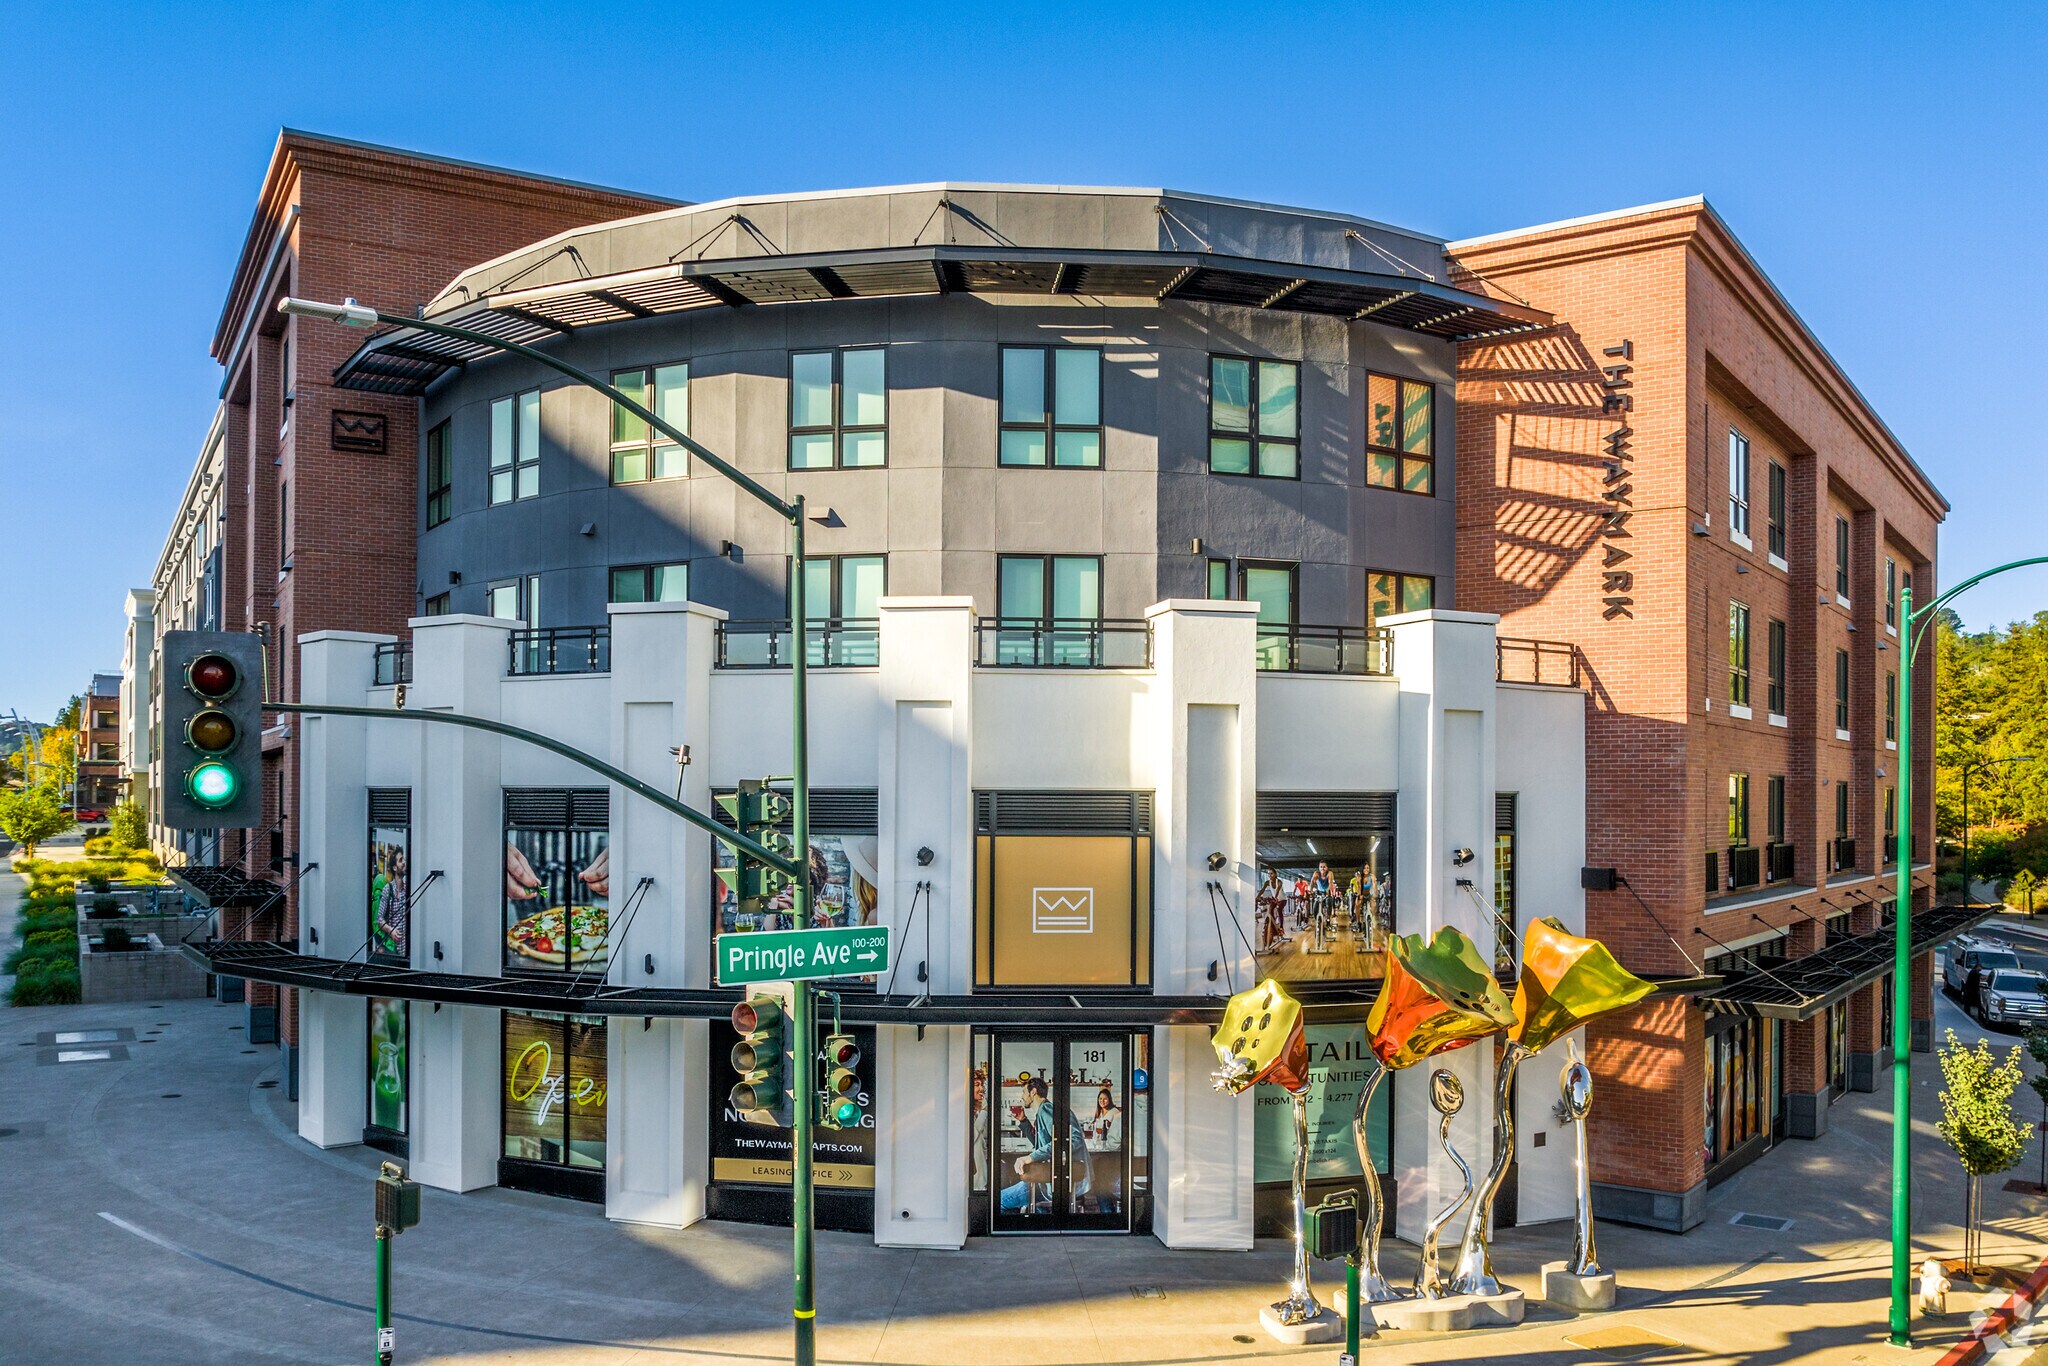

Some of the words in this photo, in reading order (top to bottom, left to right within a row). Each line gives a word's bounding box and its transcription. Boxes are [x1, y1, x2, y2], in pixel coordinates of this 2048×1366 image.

[1602, 339, 1633, 413] THE
[1602, 427, 1633, 621] WAYMARK
[729, 944, 805, 976] Pringle
[811, 942, 851, 966] Ave
[852, 937, 885, 948] 100-200
[1083, 1050, 1106, 1062] 181
[1305, 1041, 1371, 1063] TAIL
[1257, 1095, 1290, 1106] FROM
[735, 1138, 863, 1153] THEWAYMAAPTS.COM
[752, 1166, 793, 1176] LEASING
[811, 1169, 833, 1179] FICE
